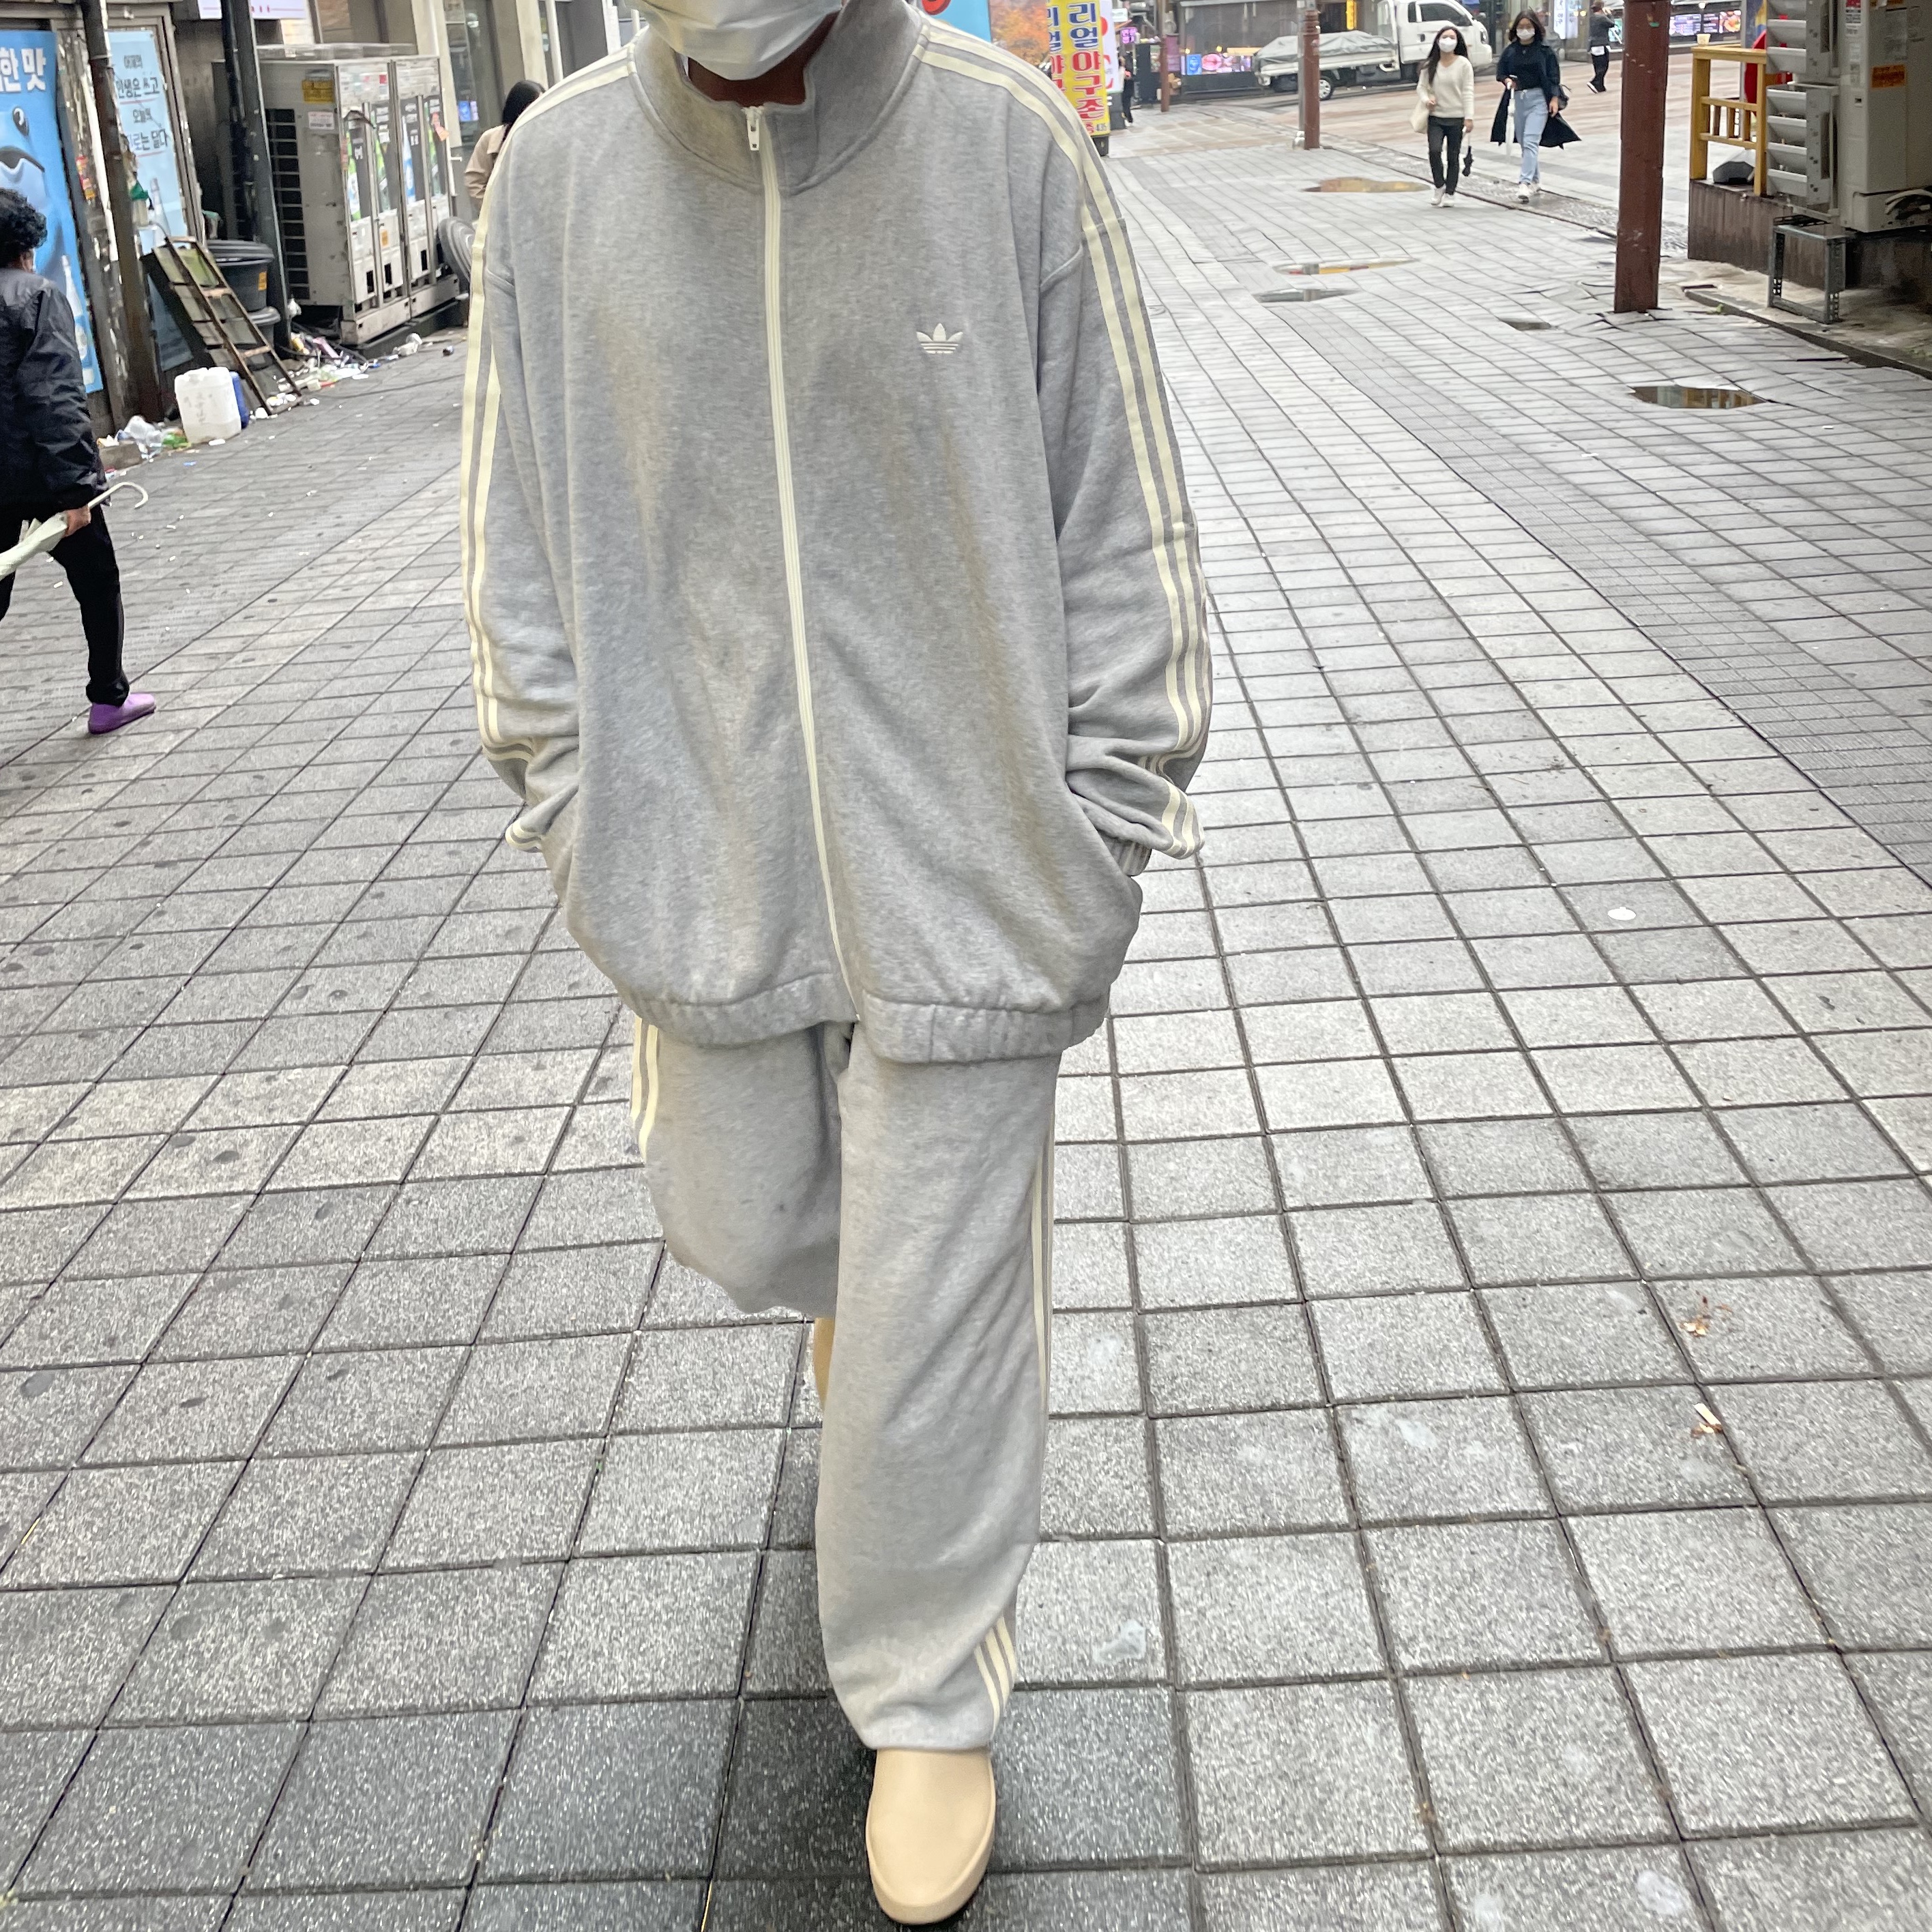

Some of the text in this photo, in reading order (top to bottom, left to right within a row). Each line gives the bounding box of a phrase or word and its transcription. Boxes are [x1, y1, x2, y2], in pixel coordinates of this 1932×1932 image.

[0, 47, 46, 92] 한 맛
[1068, 3, 1104, 119] 리얼야구존
